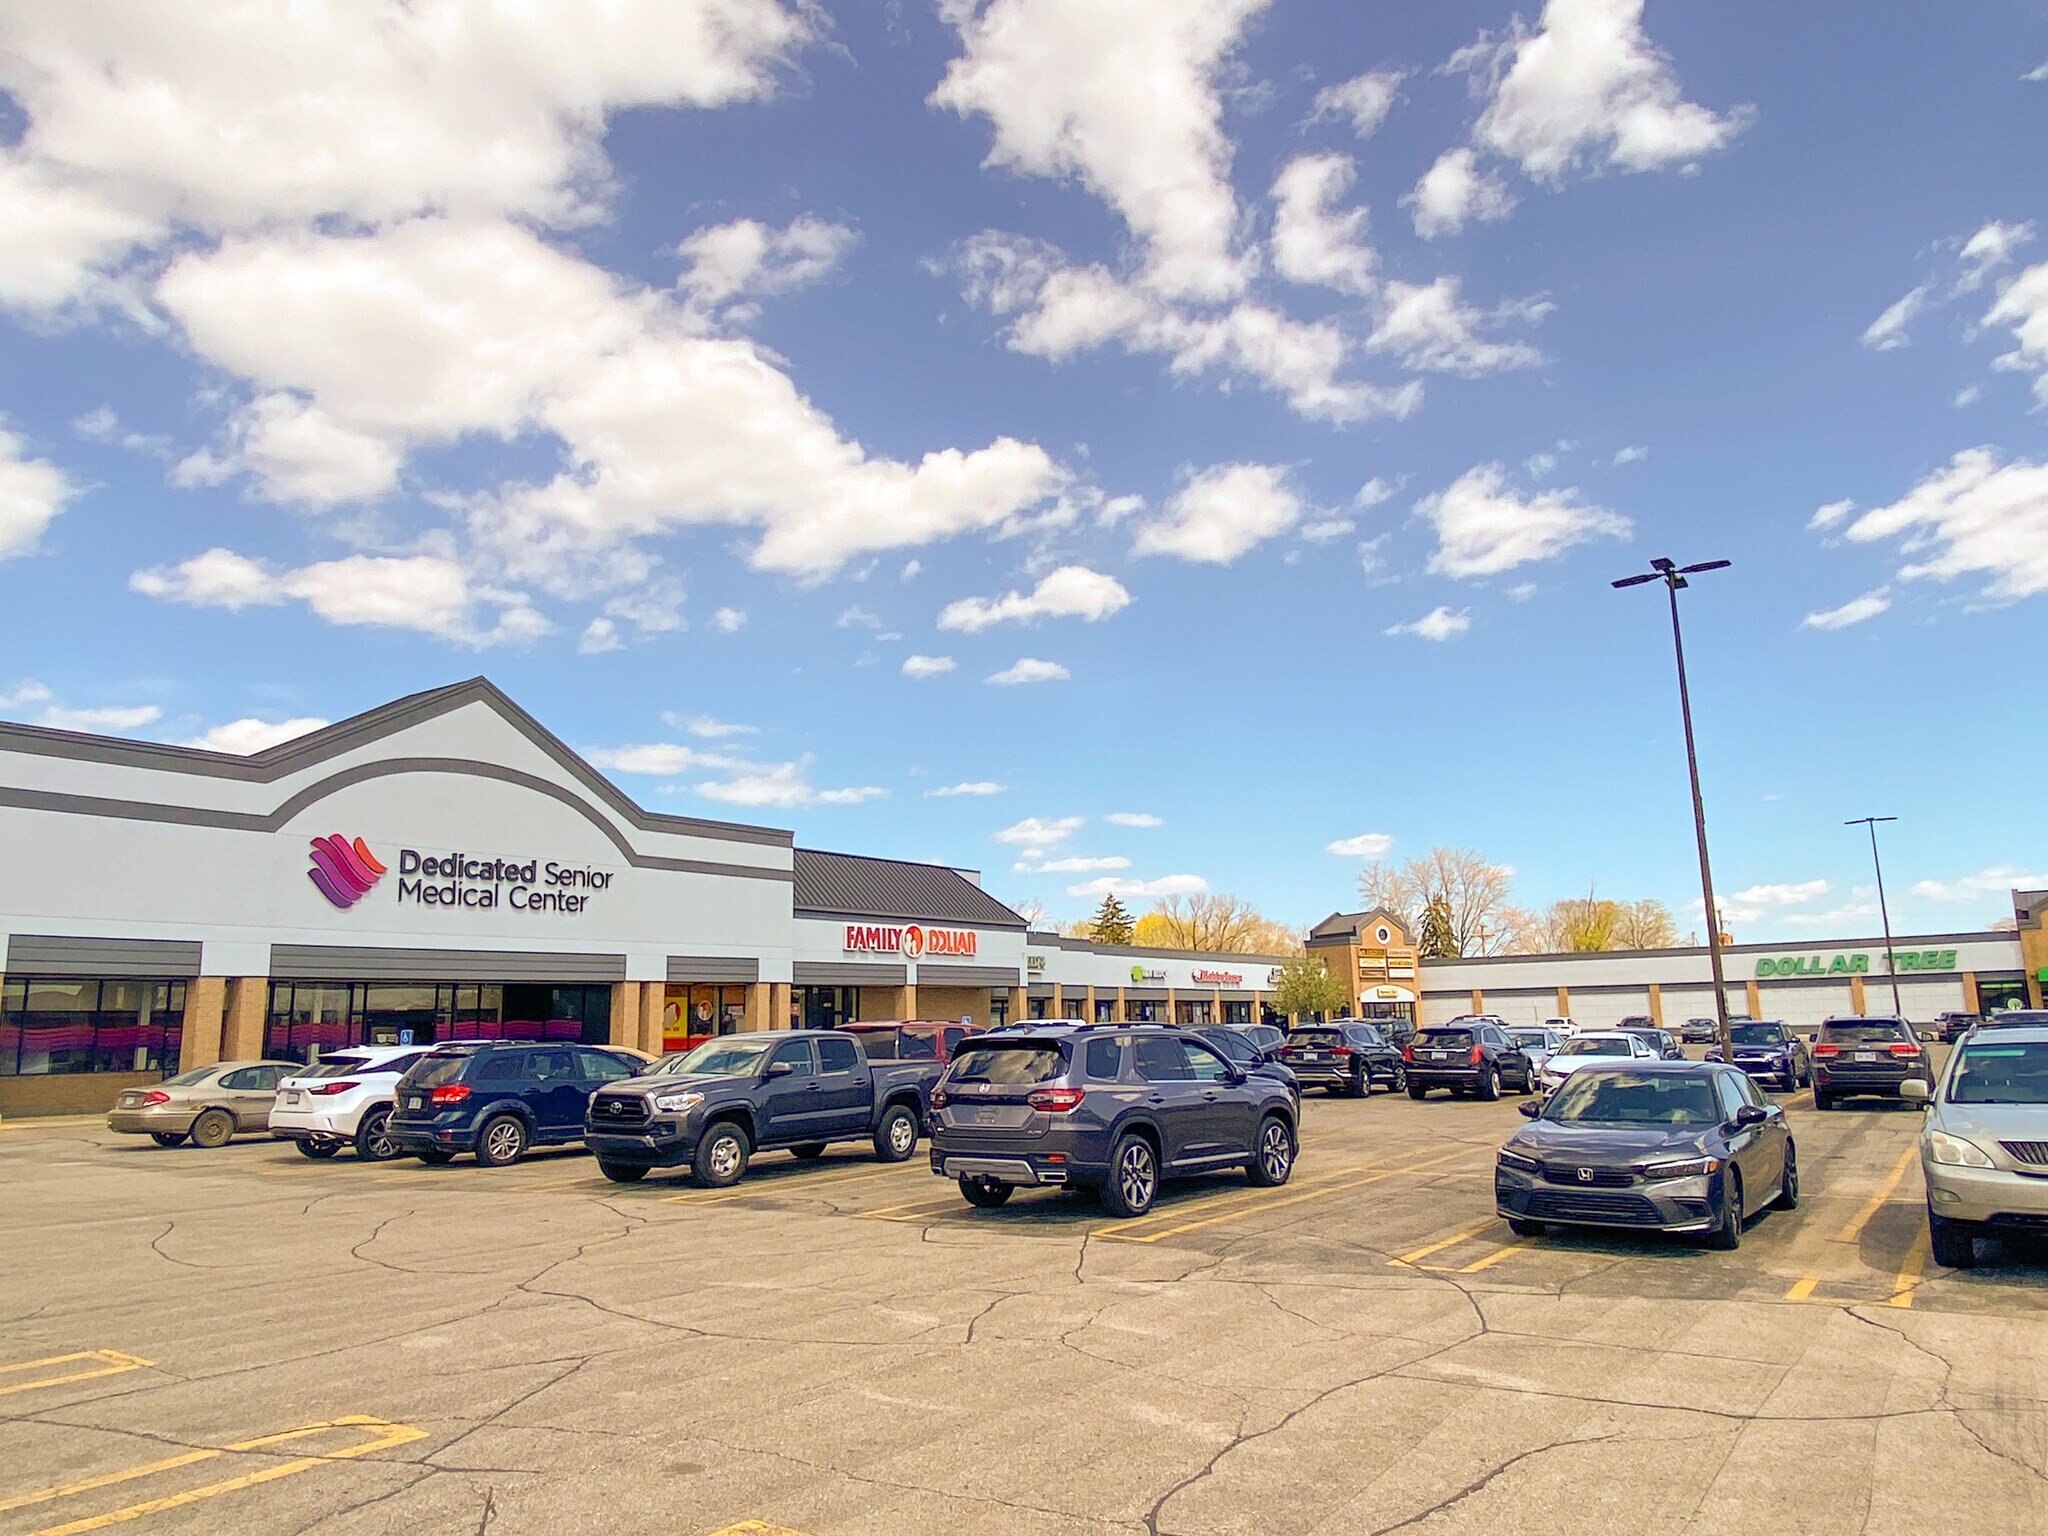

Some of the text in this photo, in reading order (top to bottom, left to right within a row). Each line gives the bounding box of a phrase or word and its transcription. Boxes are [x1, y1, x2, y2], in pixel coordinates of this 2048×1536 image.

[399, 849, 615, 890] Dedicated Senior
[398, 877, 590, 913] Medical Center
[845, 925, 977, 954] FAMILY DOLLAR
[1756, 950, 1958, 977] DOLLAR TREE
